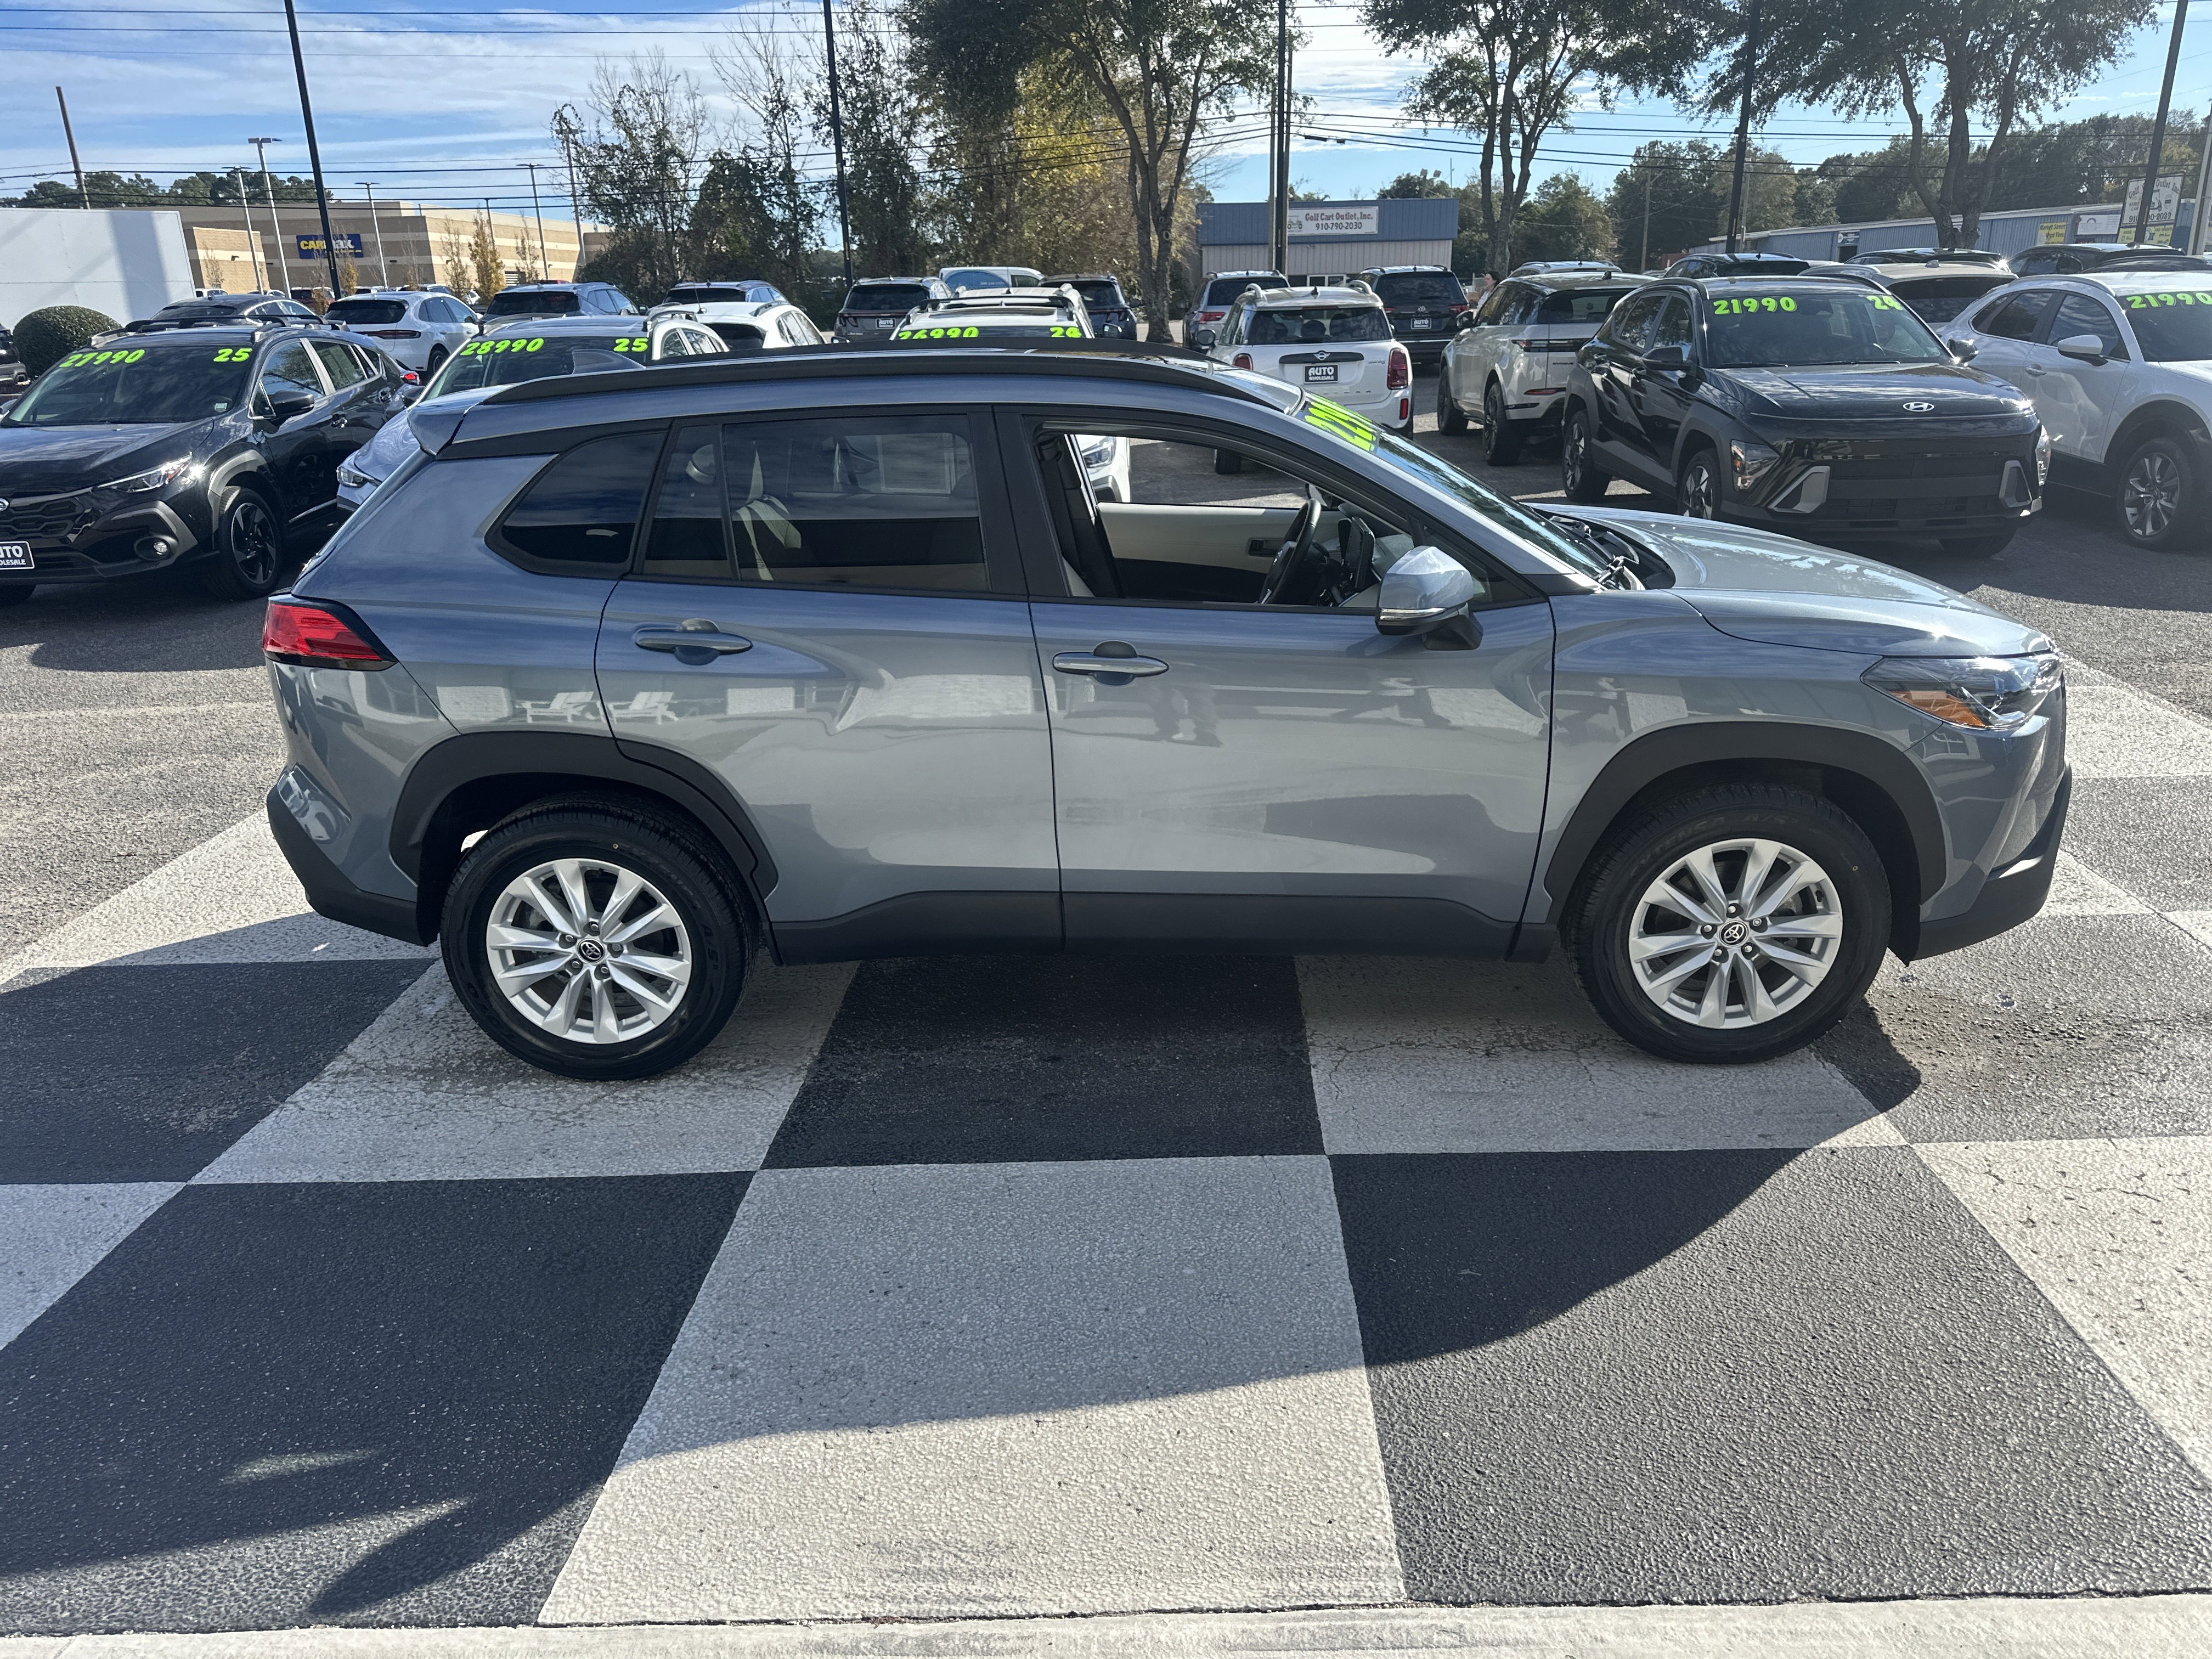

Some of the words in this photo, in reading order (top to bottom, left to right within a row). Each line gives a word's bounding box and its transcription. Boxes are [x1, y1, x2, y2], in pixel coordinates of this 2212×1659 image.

[2155, 179, 2171, 188] Outlet
[2128, 185, 2140, 199] Golf
[1305, 213, 1319, 221] Golf
[1320, 212, 1334, 221] Cart
[1360, 211, 1373, 220] Inc.
[1316, 222, 1362, 230] 910-790-2030
[1713, 297, 1798, 315] 21990
[1866, 295, 1904, 311] 24
[2126, 292, 2212, 309] 21990
[1050, 326, 1082, 338] 24
[460, 337, 545, 356] 28990
[613, 337, 649, 353] 25
[59, 348, 146, 368] 27990
[213, 347, 253, 363] 25
[1308, 366, 1335, 376] AUTO
